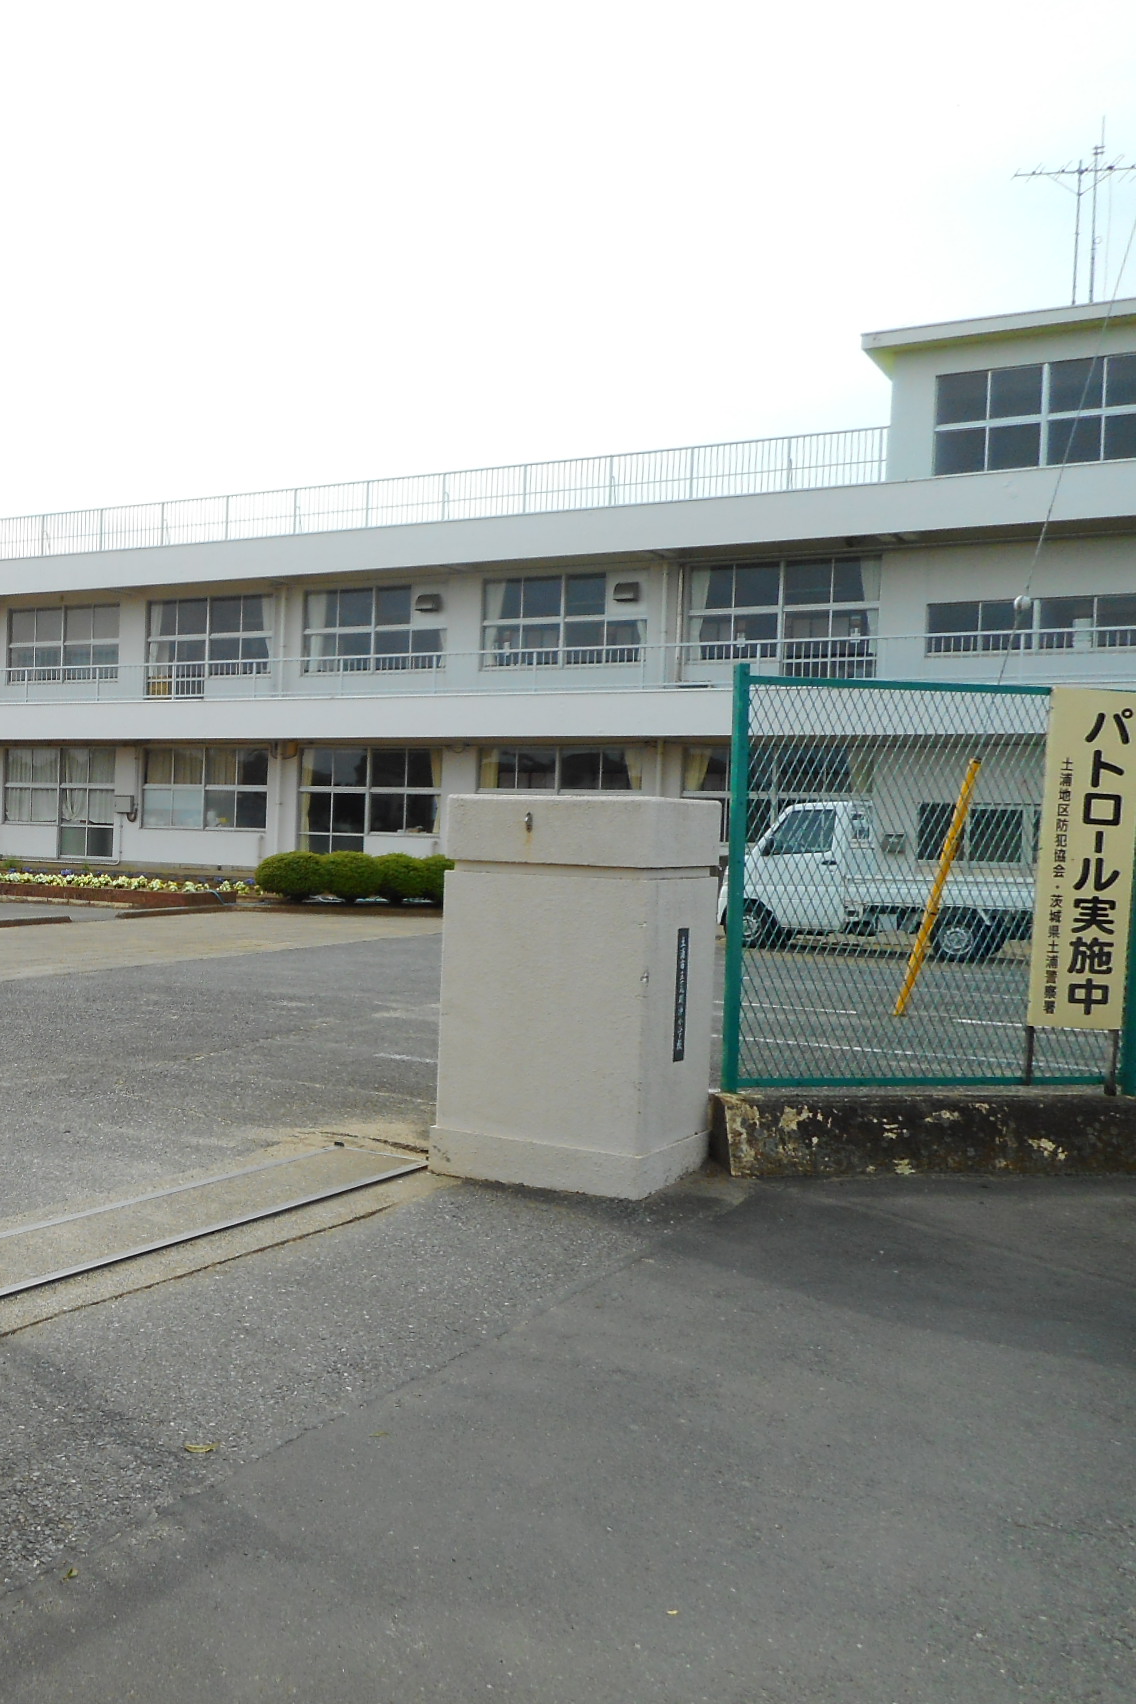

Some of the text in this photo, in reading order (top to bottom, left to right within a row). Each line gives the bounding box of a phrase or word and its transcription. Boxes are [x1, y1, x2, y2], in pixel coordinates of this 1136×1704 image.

[1067, 708, 1133, 1016] パトロール実施中
